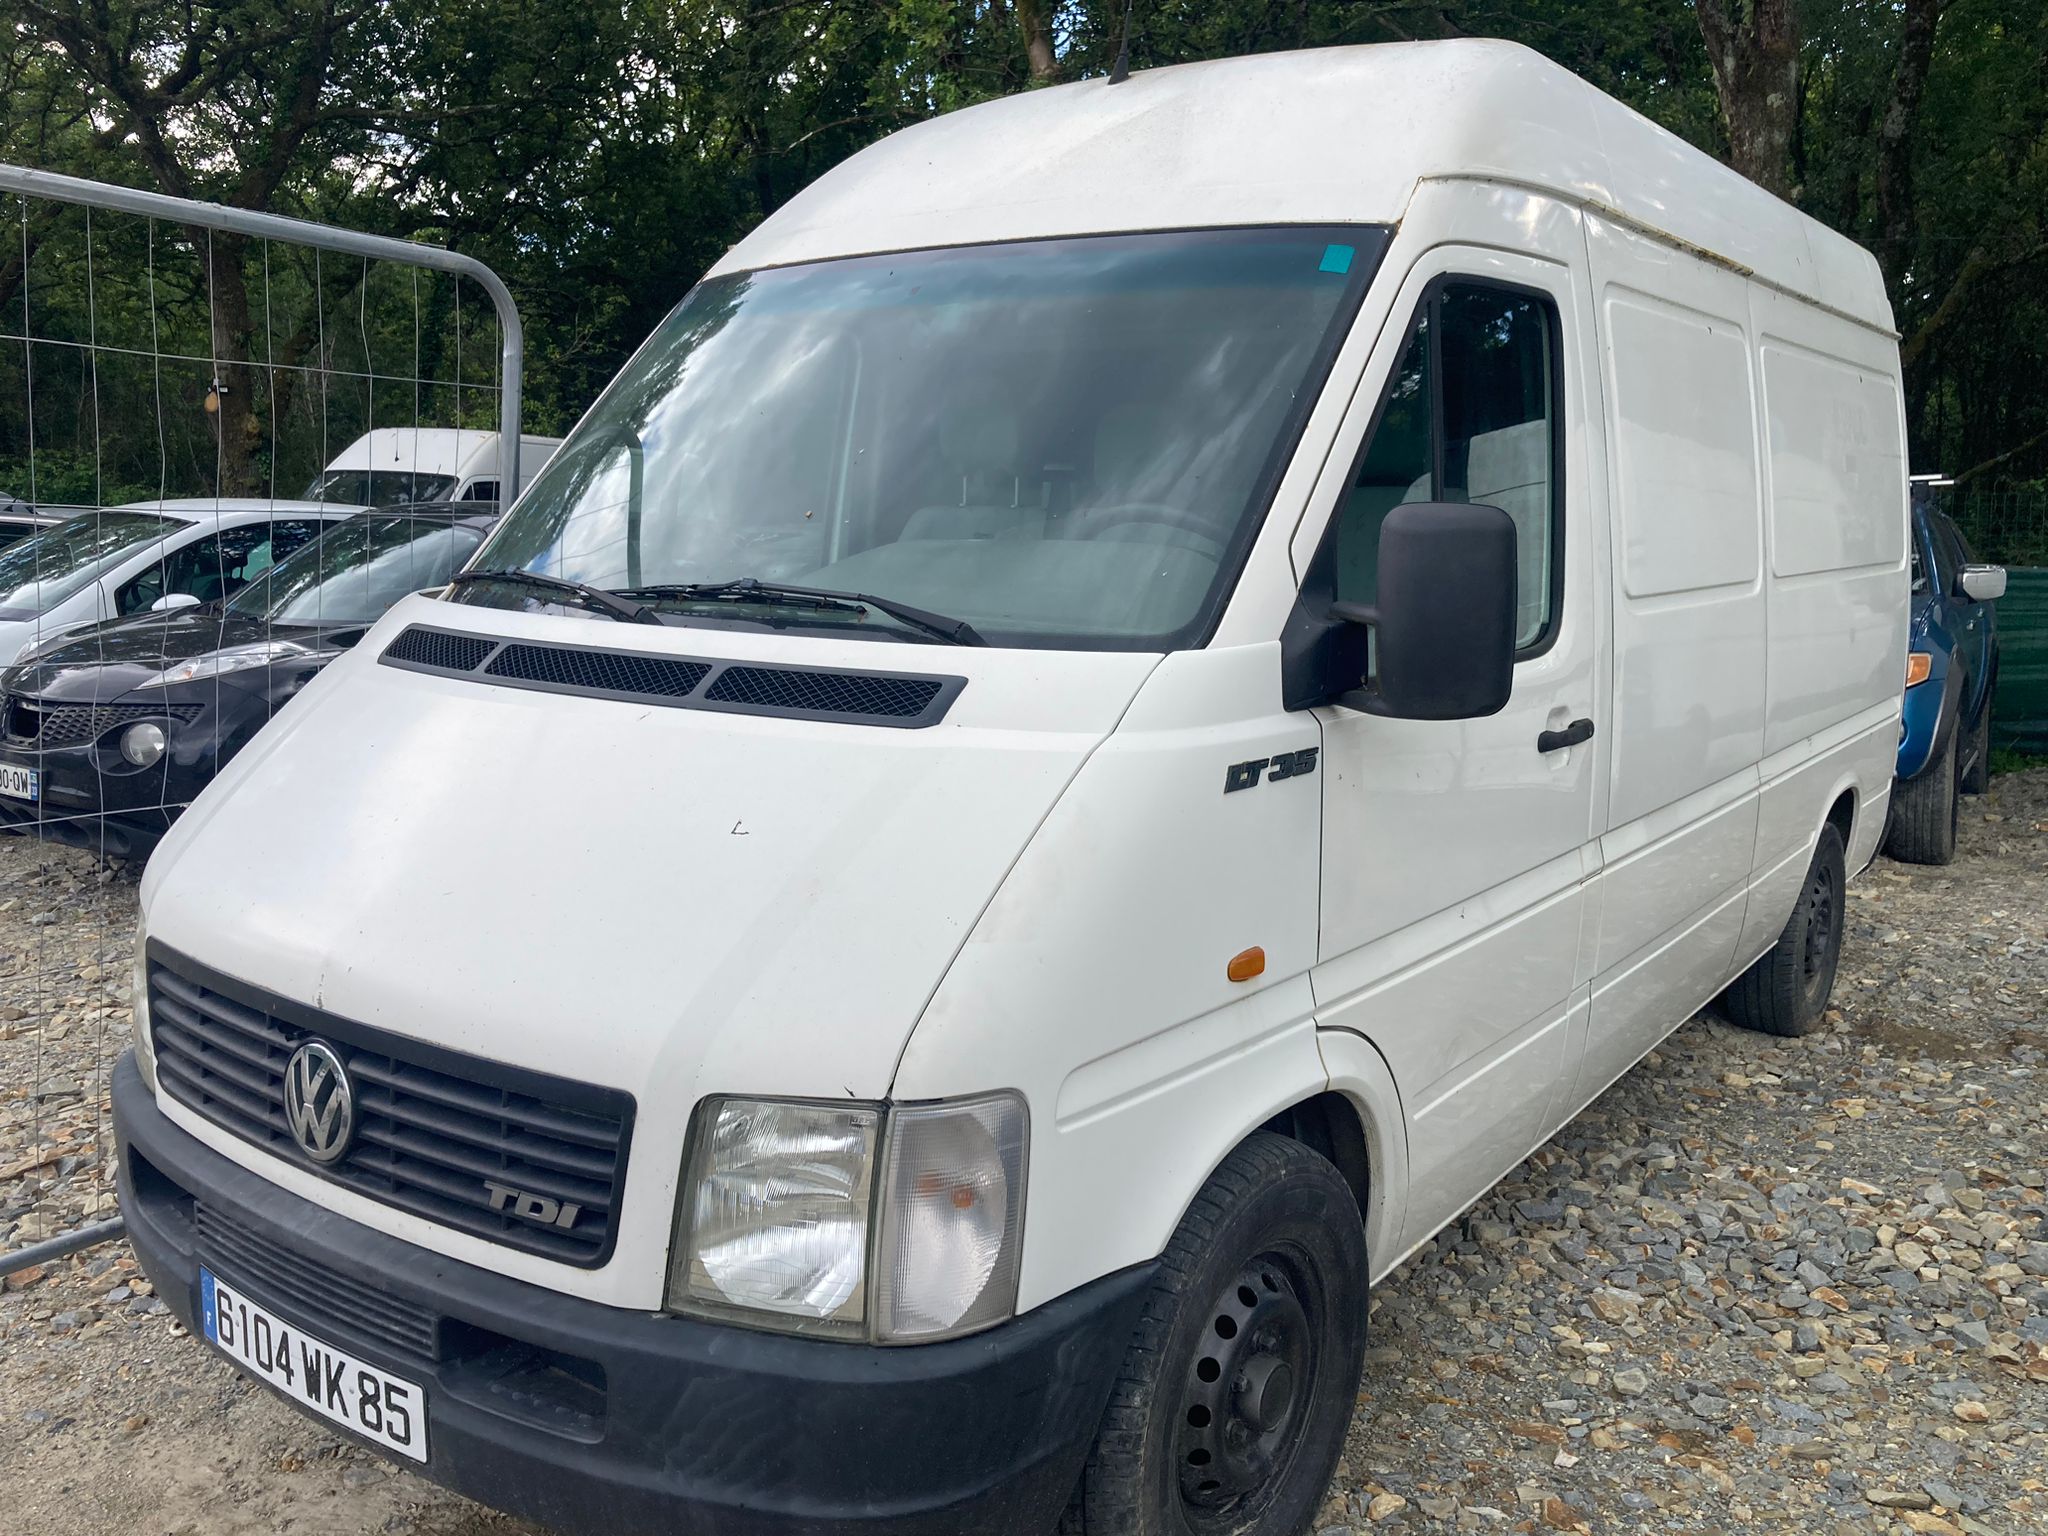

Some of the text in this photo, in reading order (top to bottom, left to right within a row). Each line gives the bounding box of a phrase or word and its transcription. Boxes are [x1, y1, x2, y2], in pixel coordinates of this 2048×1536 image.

[285, 1043, 351, 1161] VW
[483, 1180, 582, 1229] TDI
[216, 1287, 411, 1446] 6104 WK 85
